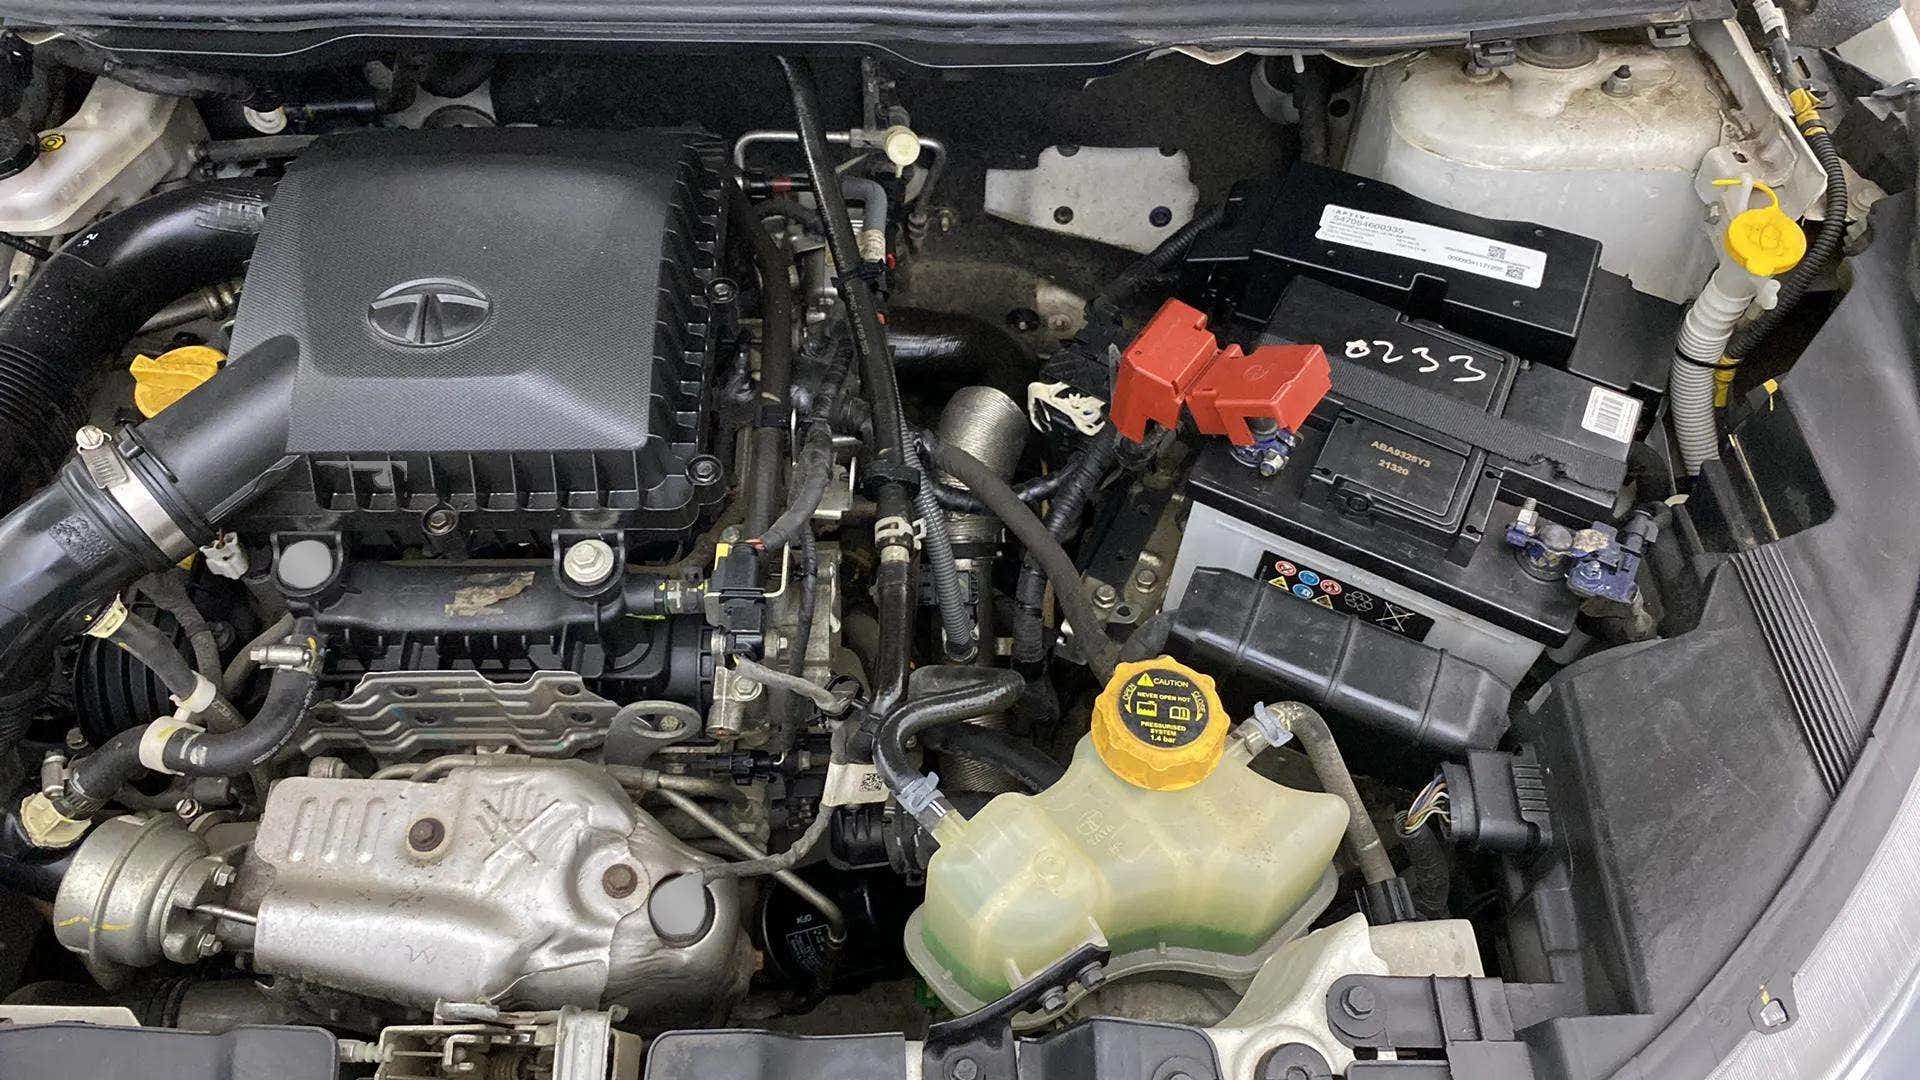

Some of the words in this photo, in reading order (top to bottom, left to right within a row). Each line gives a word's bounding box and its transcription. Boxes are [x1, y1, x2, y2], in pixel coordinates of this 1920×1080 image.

[1345, 339, 1487, 382] 0233
[1153, 677, 1189, 688] CAUTION
[1122, 682, 1136, 701] OPEN
[1136, 691, 1158, 700] NEVER
[1159, 693, 1177, 701] OPEN
[1140, 720, 1187, 732] PRESSURISED
[1150, 728, 1177, 737] SYSTEM
[1150, 734, 1162, 742] 1.4
[1162, 736, 1176, 744] bar
